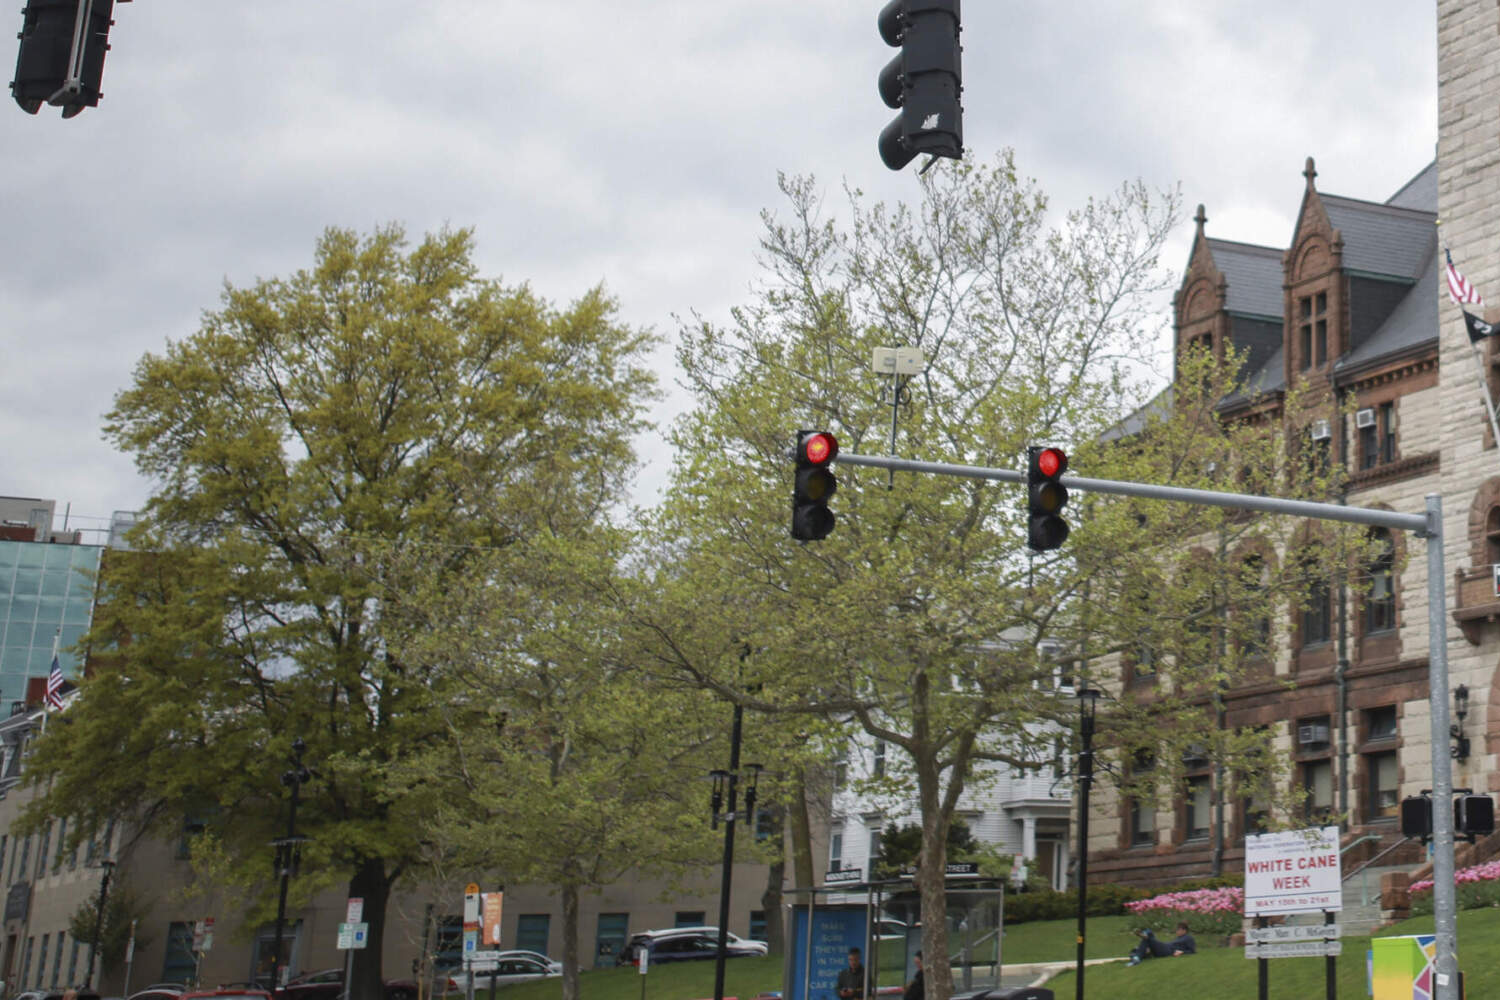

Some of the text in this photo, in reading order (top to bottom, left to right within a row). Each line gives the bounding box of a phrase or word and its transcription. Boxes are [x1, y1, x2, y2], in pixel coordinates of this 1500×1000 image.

[1248, 854, 1336, 873] WHITE CANE
[1272, 875, 1311, 889] WEEK
